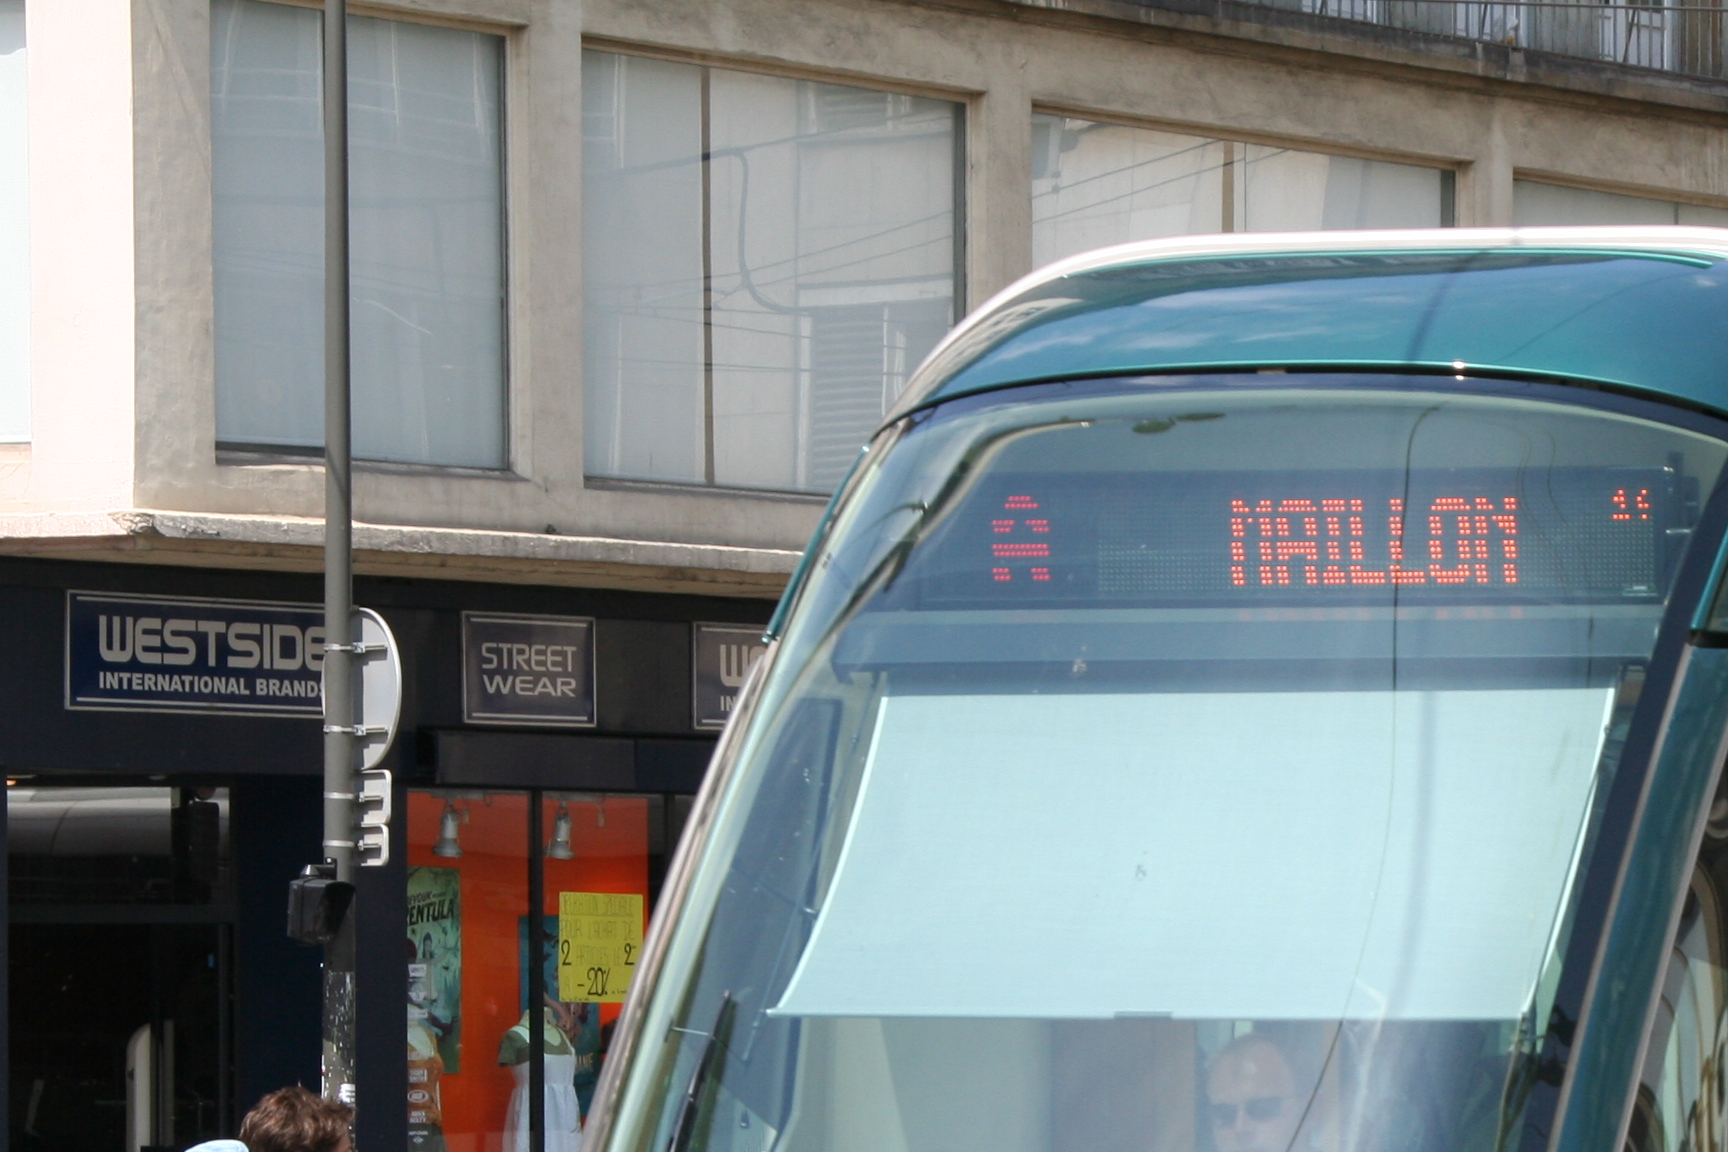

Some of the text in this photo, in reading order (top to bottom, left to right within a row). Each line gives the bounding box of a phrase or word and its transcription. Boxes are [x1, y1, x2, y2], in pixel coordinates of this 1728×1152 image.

[992, 495, 1050, 583] A
[1230, 497, 1519, 587] MAILLON
[98, 613, 327, 673] WESTSIDE
[481, 642, 577, 672] STREET
[99, 670, 250, 696] INTERNATIONAL
[482, 674, 577, 698] WEAR
[561, 939, 572, 966] 2
